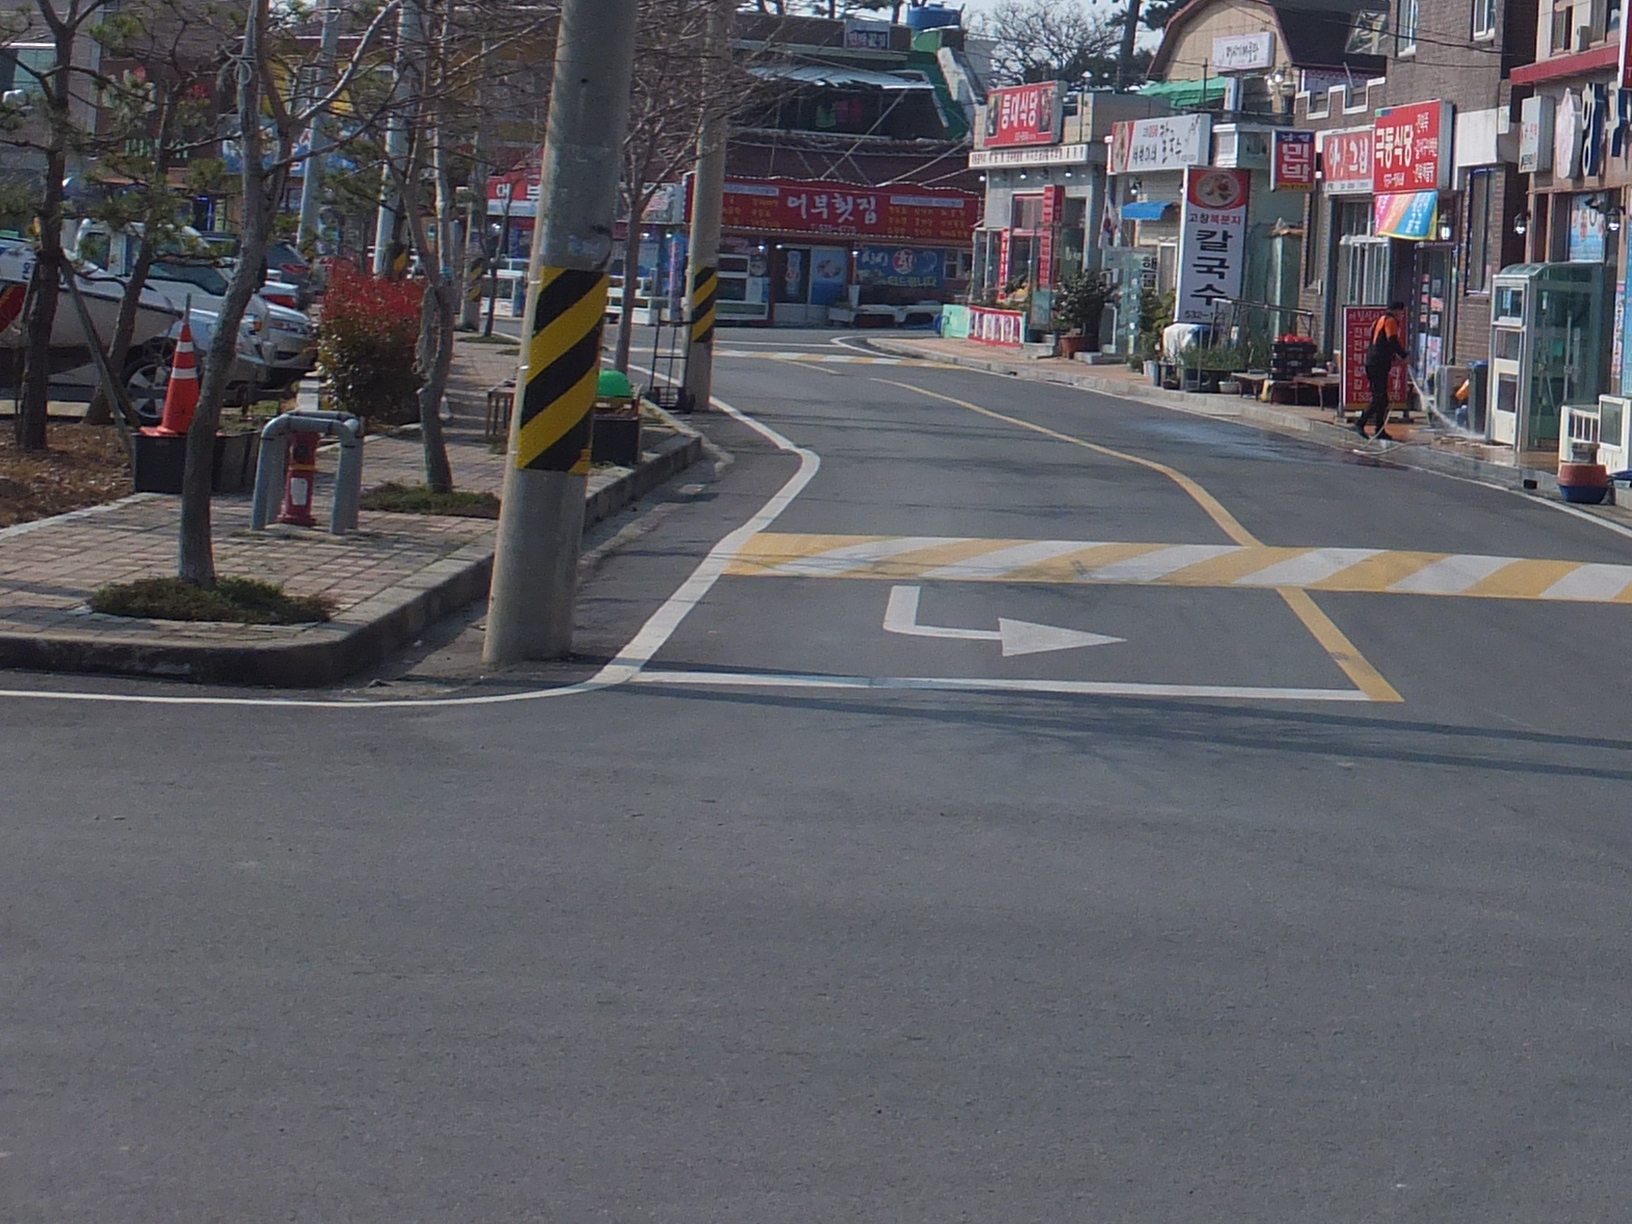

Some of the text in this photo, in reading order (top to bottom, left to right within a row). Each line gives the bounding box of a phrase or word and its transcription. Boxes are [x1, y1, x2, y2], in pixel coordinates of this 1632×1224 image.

[1000, 89, 1039, 130] 등대식당
[1281, 142, 1311, 183] 민박
[1375, 124, 1414, 169] 극동식당
[787, 193, 878, 225] 어부횟집
[1190, 229, 1234, 307] 칼국수
